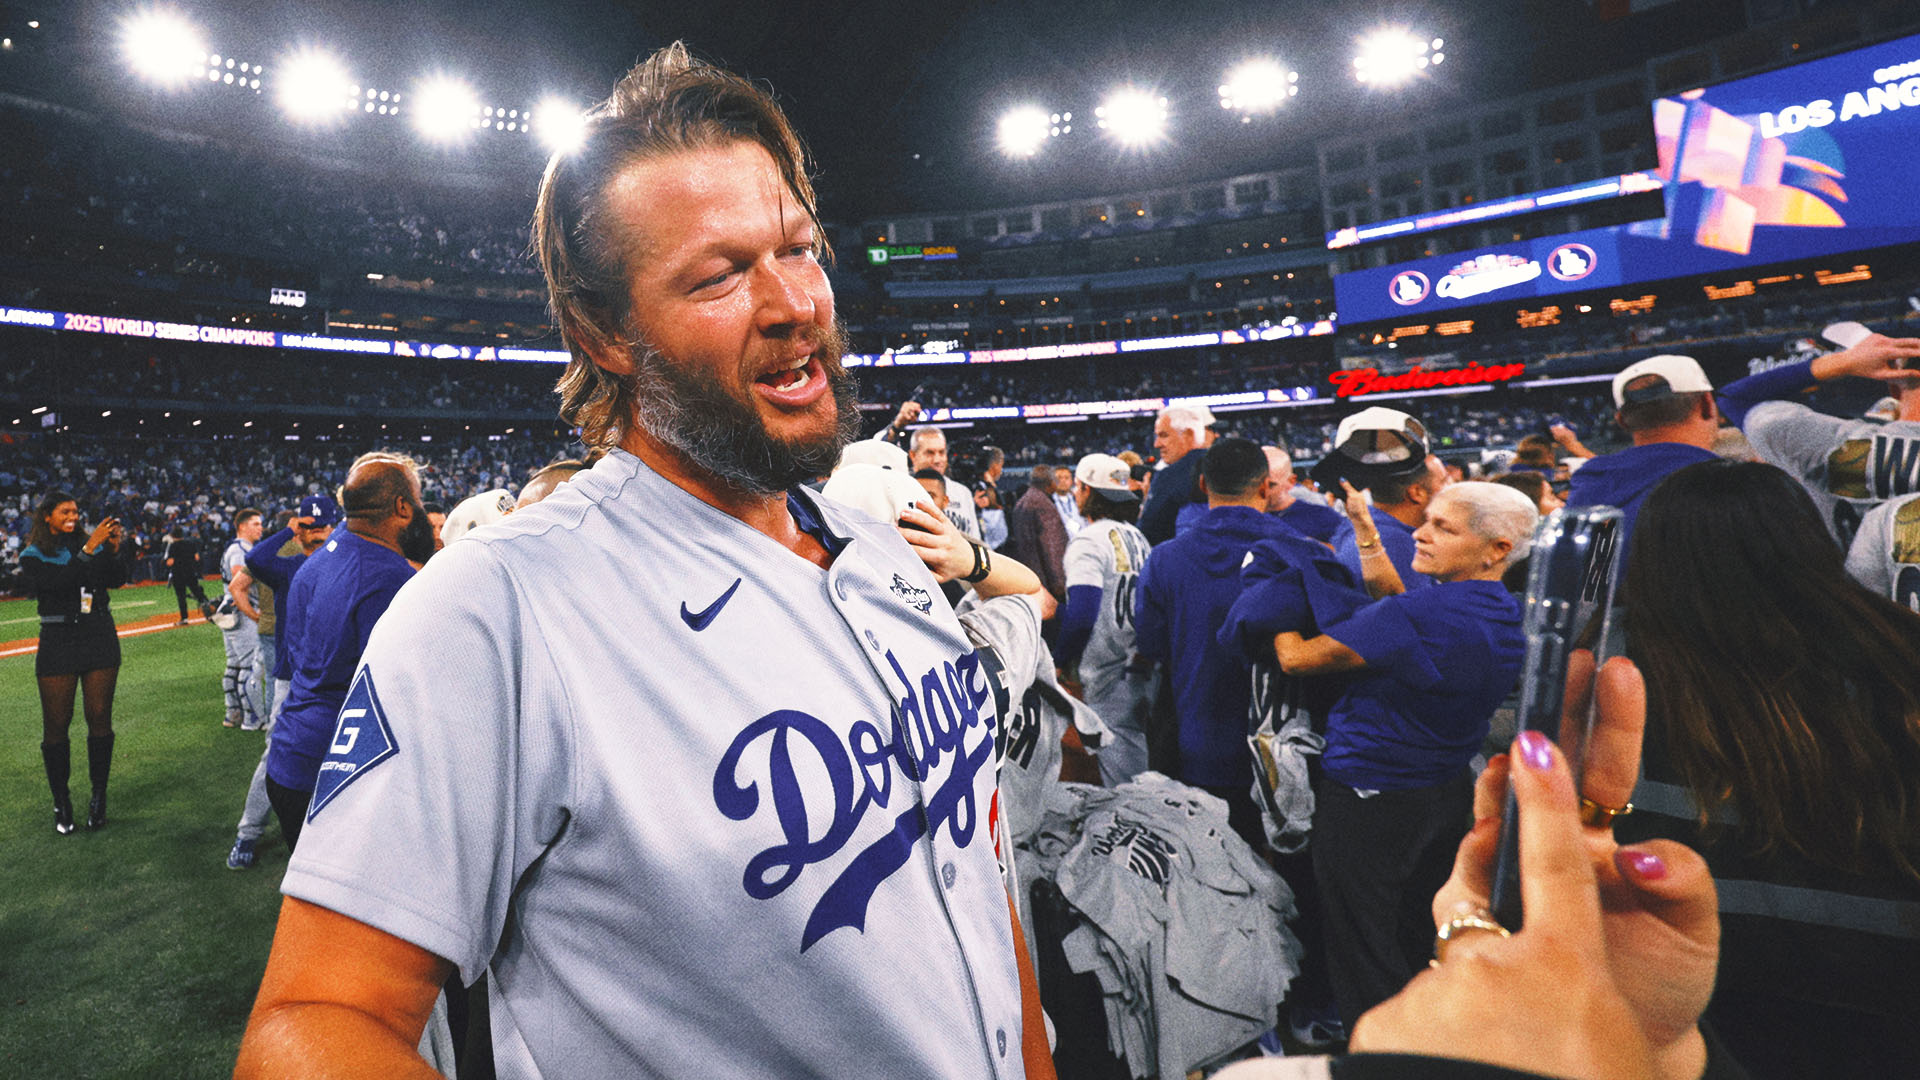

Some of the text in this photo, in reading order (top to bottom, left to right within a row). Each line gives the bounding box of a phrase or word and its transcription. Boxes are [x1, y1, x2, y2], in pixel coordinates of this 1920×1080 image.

[1759, 99, 1836, 139] LOS
[268, 288, 306, 307] KPMG
[64, 313, 276, 347] 2025 WORLD SERIES CHAMPIONS
[1329, 361, 1525, 398] Budweiser
[713, 648, 995, 900] Dodger
